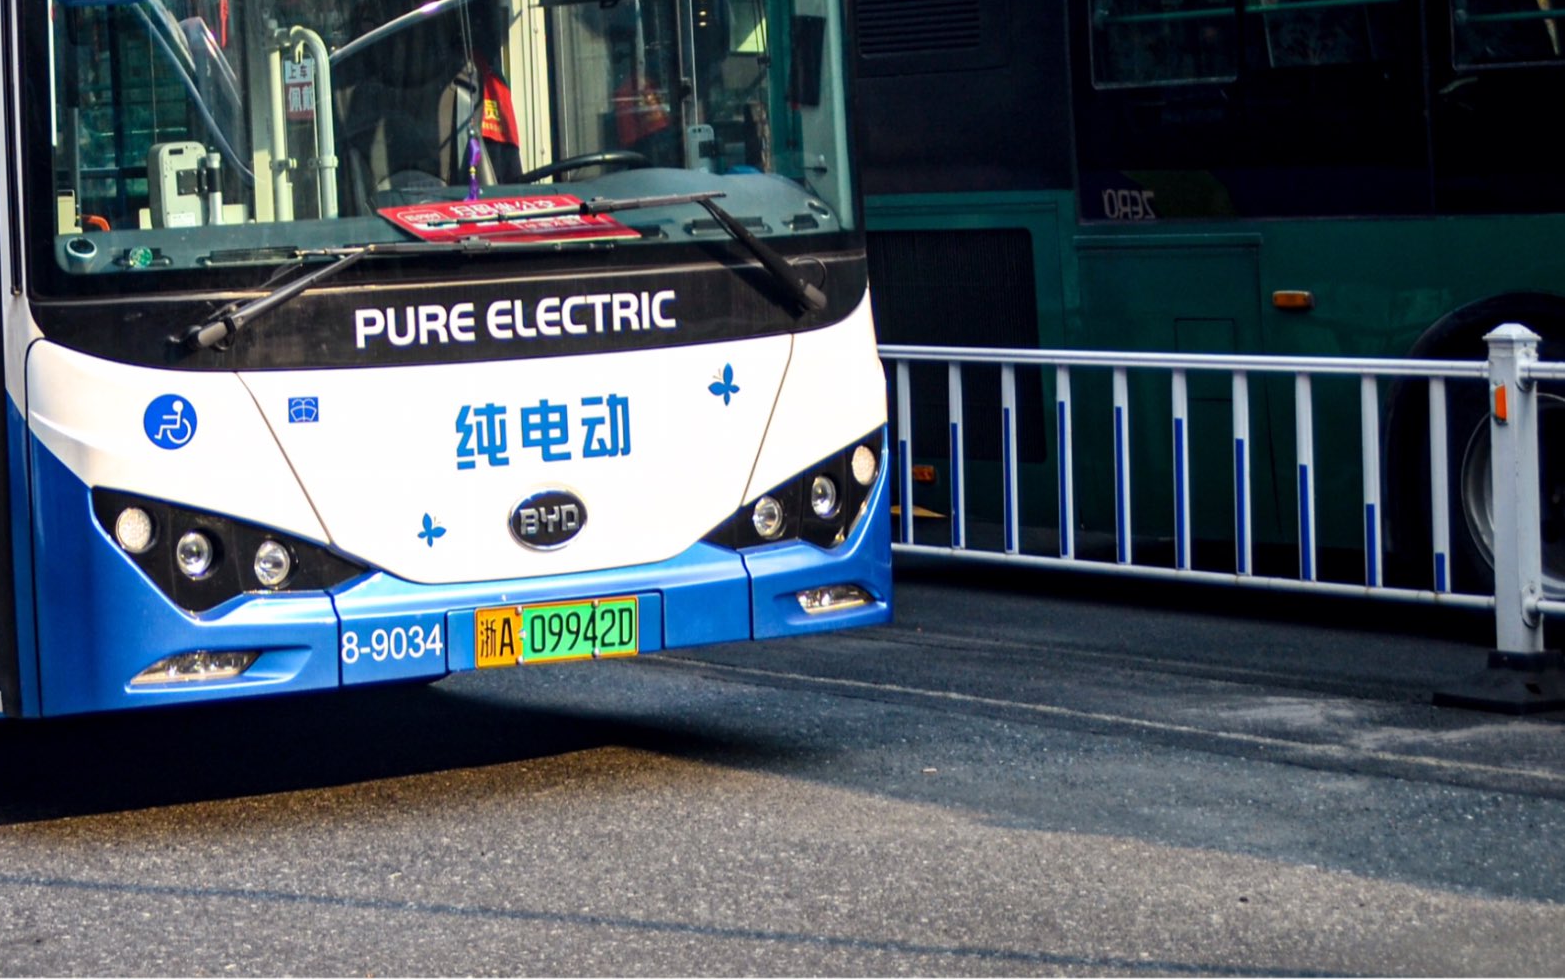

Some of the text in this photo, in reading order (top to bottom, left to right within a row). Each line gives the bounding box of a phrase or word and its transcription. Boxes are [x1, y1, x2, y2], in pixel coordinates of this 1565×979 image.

[355, 290, 676, 348] PURE ELECTRIC
[455, 393, 631, 470] 纯电动
[519, 503, 580, 535] BYD
[341, 623, 443, 664] 8-9034
[479, 607, 634, 658] 浙A 09942D
